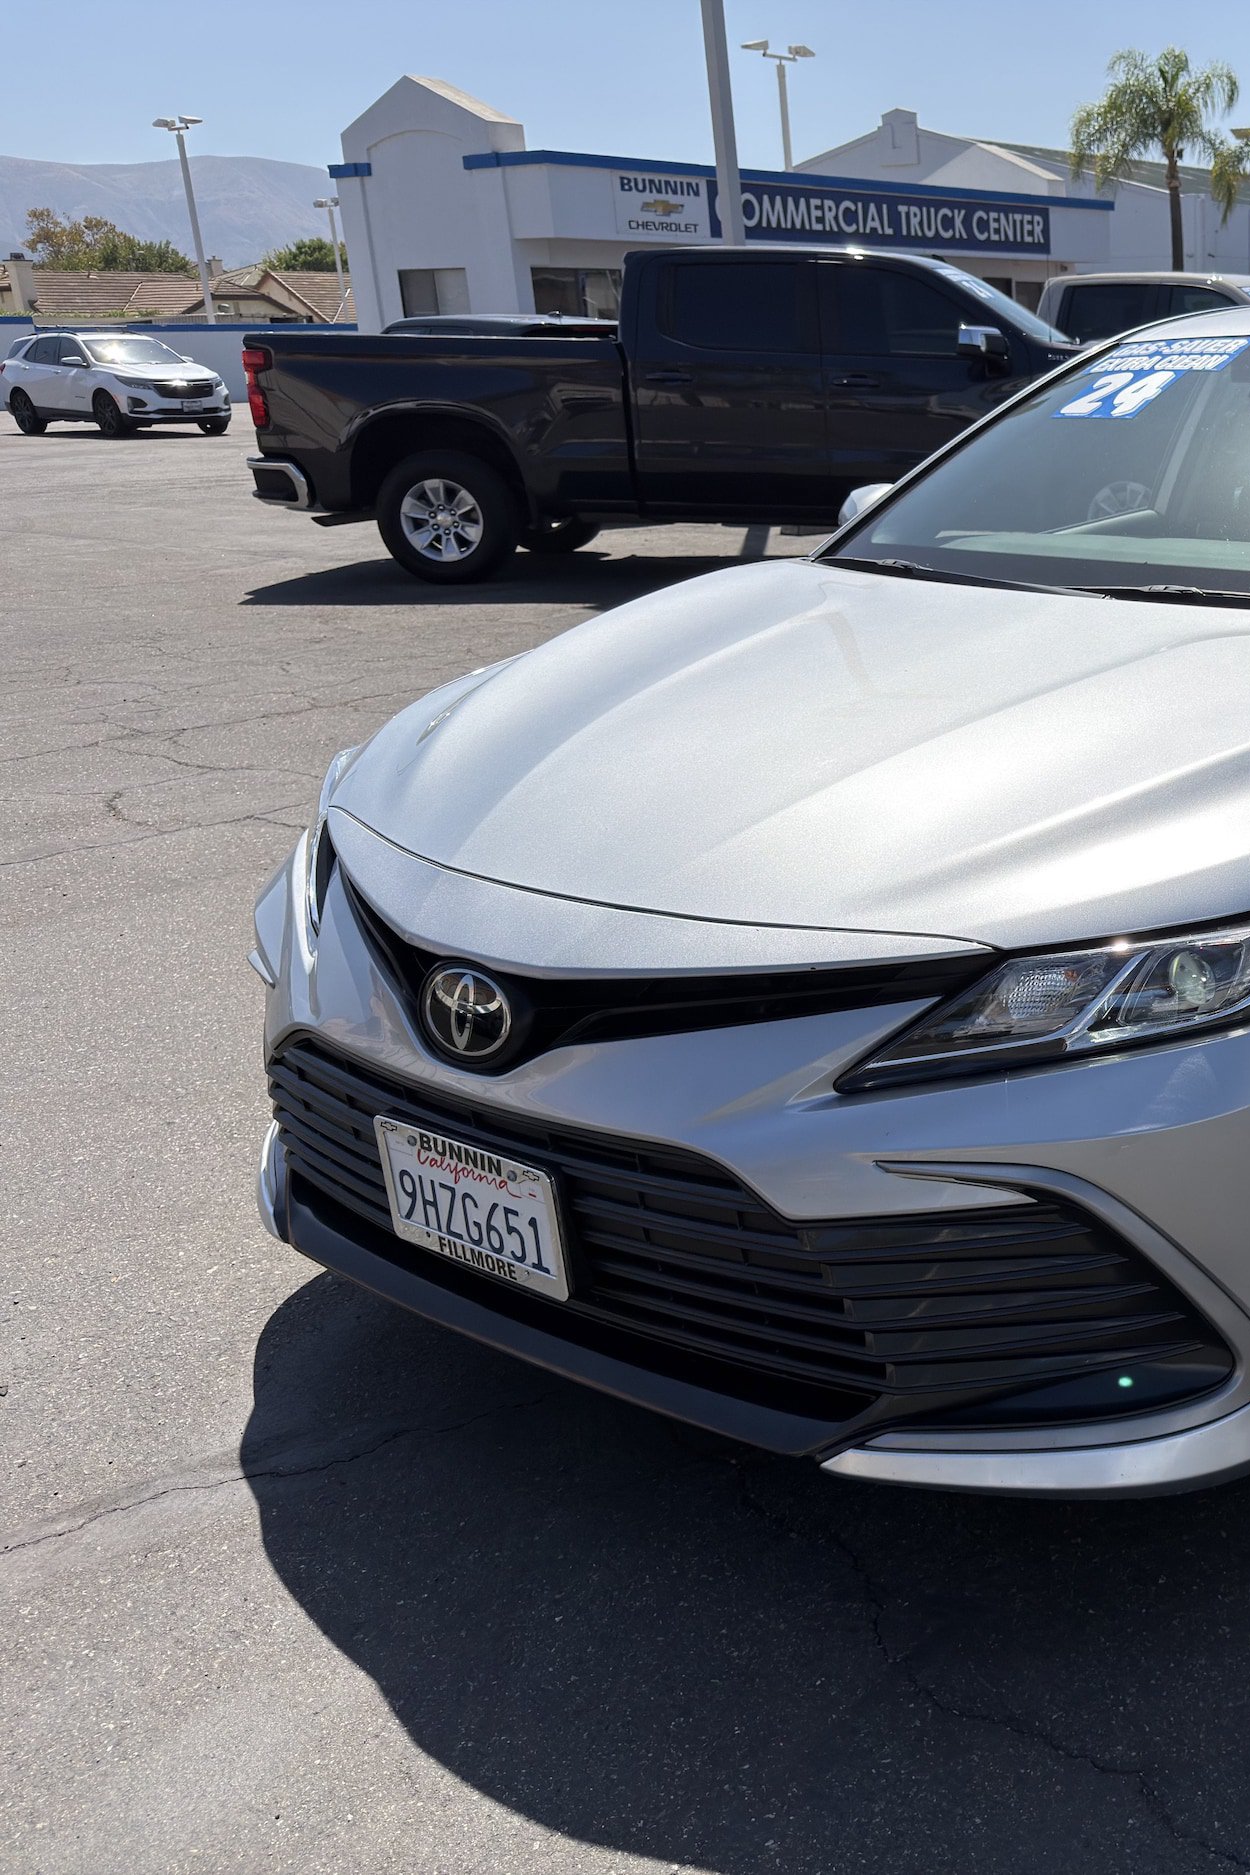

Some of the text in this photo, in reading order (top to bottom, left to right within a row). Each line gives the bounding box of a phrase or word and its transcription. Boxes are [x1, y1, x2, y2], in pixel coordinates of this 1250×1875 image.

[619, 176, 700, 197] BUNNIN
[628, 220, 699, 233] CHEVROLET
[897, 204, 968, 239] TRUCK
[972, 210, 1045, 243] CENTER
[1090, 356, 1162, 373] EXTRA
[1153, 355, 1230, 371] CLEAN
[1059, 371, 1176, 417] 24
[417, 1149, 522, 1199] California
[418, 1133, 503, 1178] BUNNIN
[399, 1169, 551, 1274] 9HZG651
[438, 1235, 518, 1281] FILLMORE
